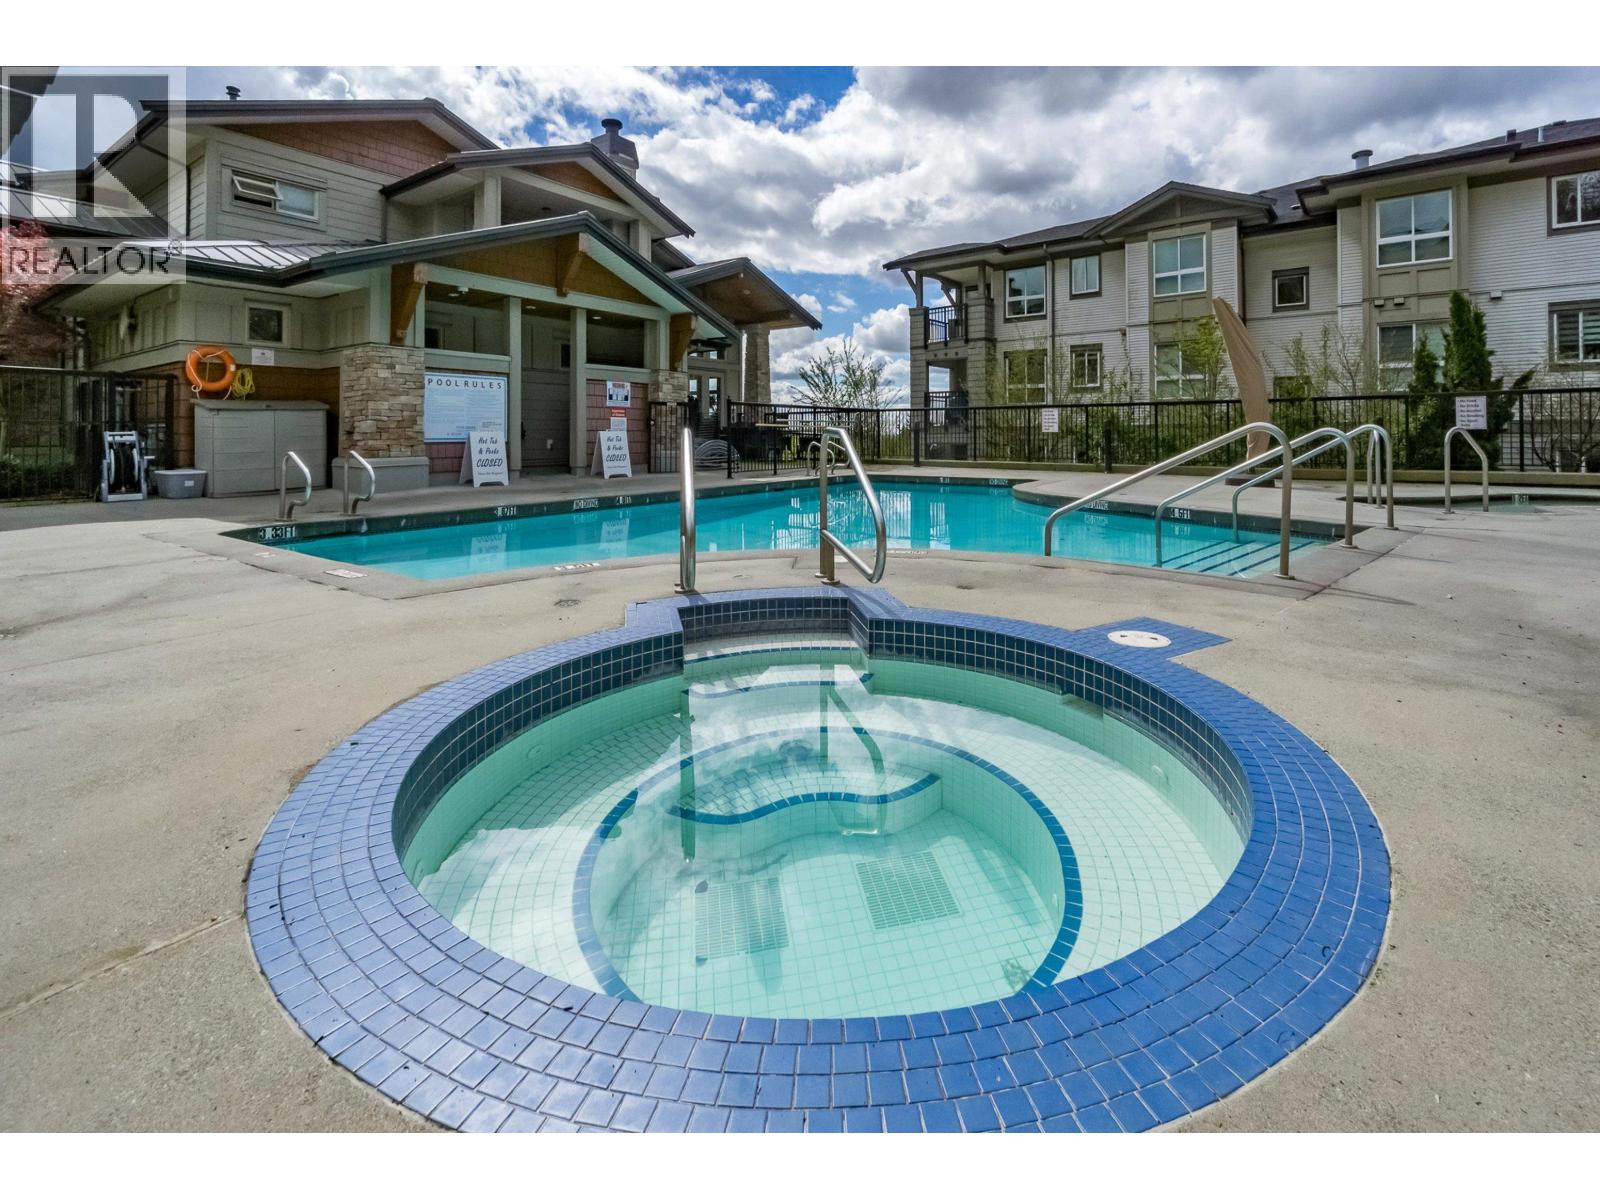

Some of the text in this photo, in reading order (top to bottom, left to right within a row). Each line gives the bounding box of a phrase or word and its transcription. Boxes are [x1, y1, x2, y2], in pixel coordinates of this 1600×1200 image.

[428, 378, 502, 389] POOL RULES
[476, 458, 504, 467] CLOSED
[605, 454, 628, 462] CLOSED
